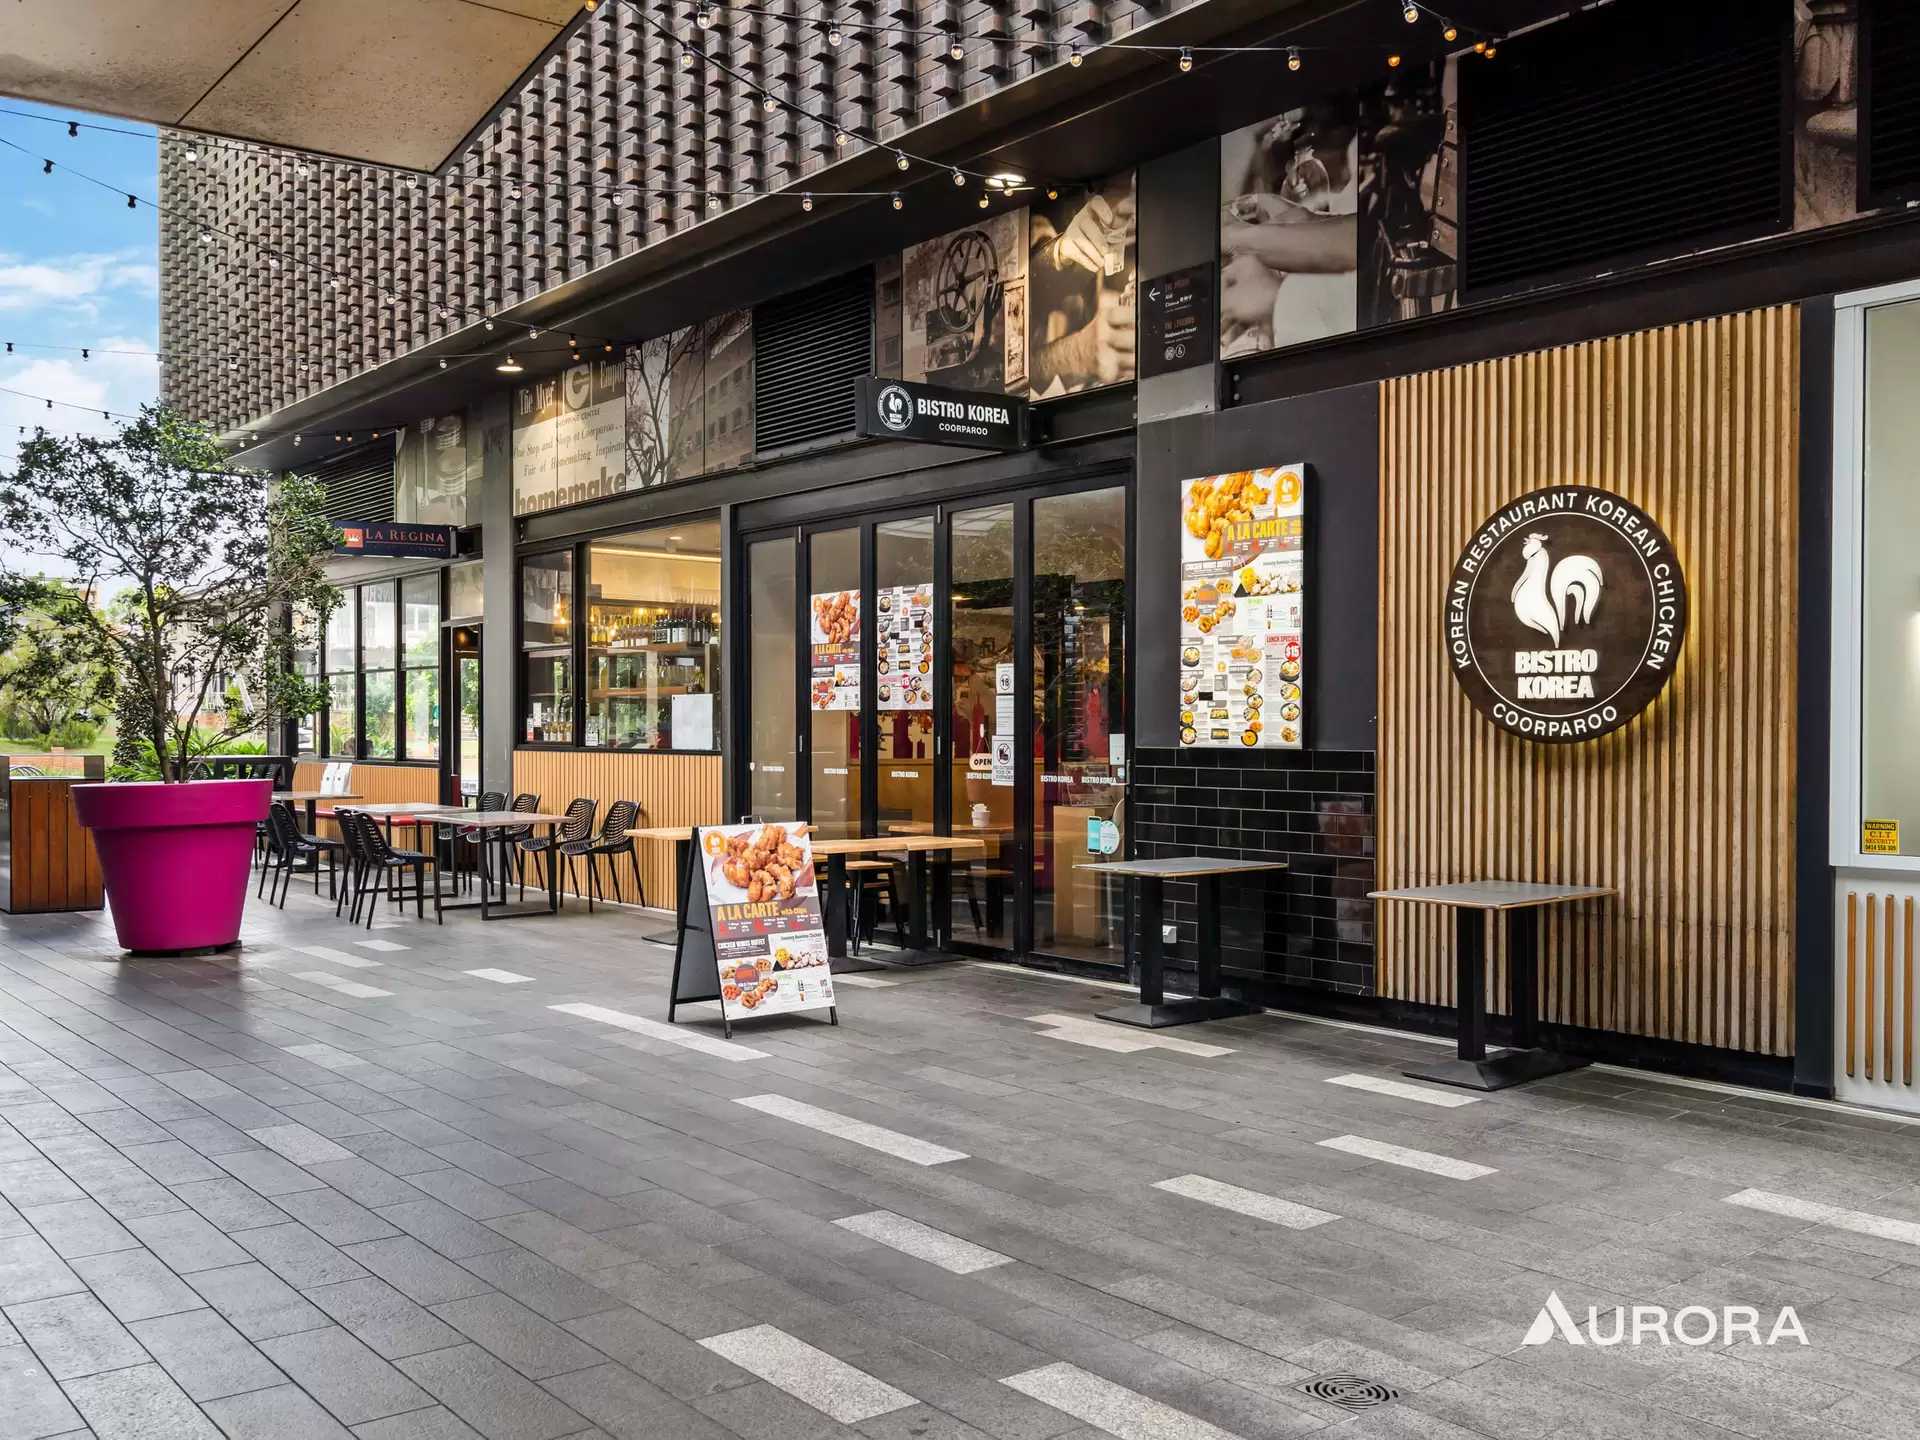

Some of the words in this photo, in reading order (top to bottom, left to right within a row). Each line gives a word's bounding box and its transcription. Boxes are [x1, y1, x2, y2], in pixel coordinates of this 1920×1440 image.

[917, 398, 965, 419] BISTRO
[968, 405, 1010, 425] KOREA
[938, 422, 988, 436] COORPAROO
[1237, 523, 1251, 540] LA
[1253, 519, 1288, 538] CARTE
[1450, 580, 1471, 668] KOREAN
[1462, 492, 1578, 573] RESTAURANT
[1585, 494, 1661, 558] KOREAN
[1646, 563, 1676, 670] CHICKEN
[1286, 645, 1300, 657] $15
[1515, 649, 1598, 674] BISTRO
[1001, 678, 1010, 687] 18
[1517, 675, 1594, 699] KOREA
[1493, 702, 1617, 737] COORPAROO
[1040, 775, 1057, 783] BISTRO
[1081, 776, 1099, 784] BISTRO
[718, 905, 726, 921] A
[727, 904, 741, 921] LA
[743, 901, 779, 919] CARTE
